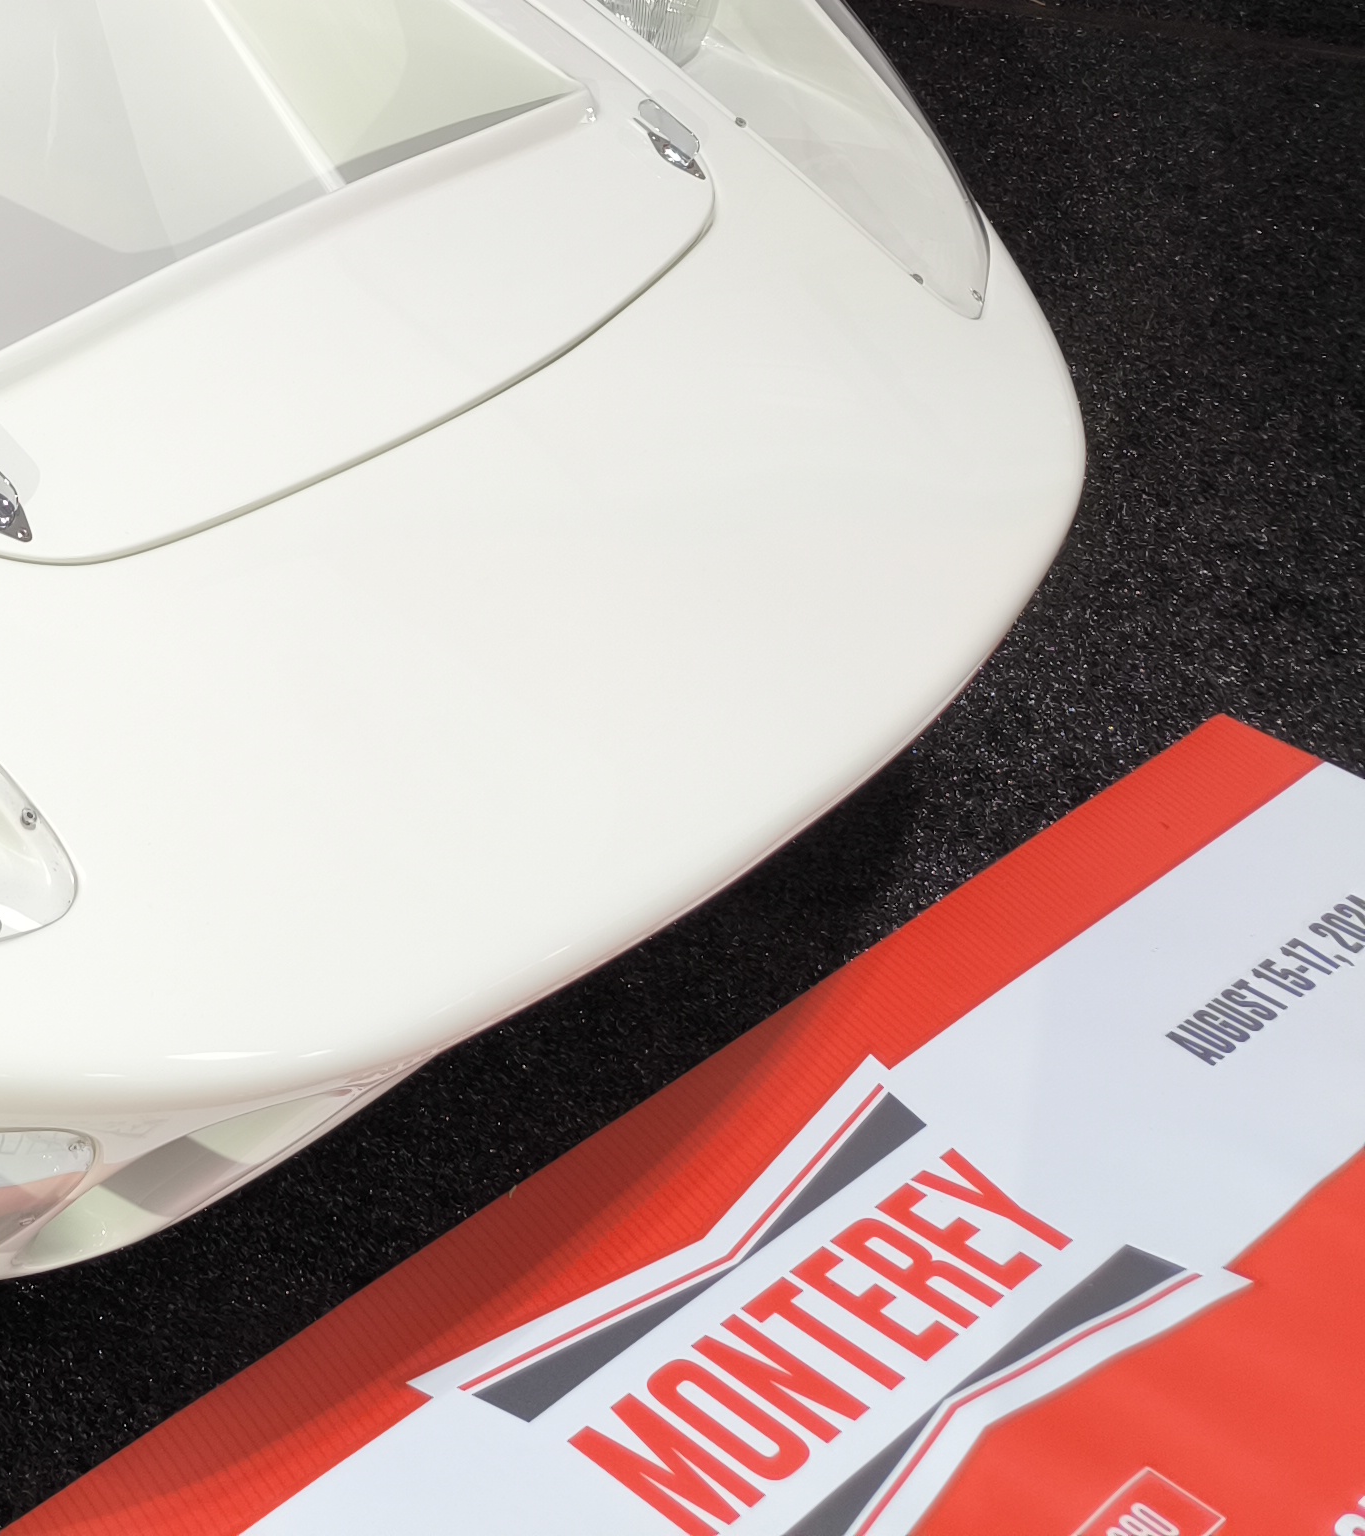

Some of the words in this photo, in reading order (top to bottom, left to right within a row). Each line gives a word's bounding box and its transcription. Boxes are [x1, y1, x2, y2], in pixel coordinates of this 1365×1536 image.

[1165, 978, 1289, 1066] AUGUST
[1251, 937, 1356, 998] 15-17,
[567, 1147, 1073, 1536] MONTEREY
